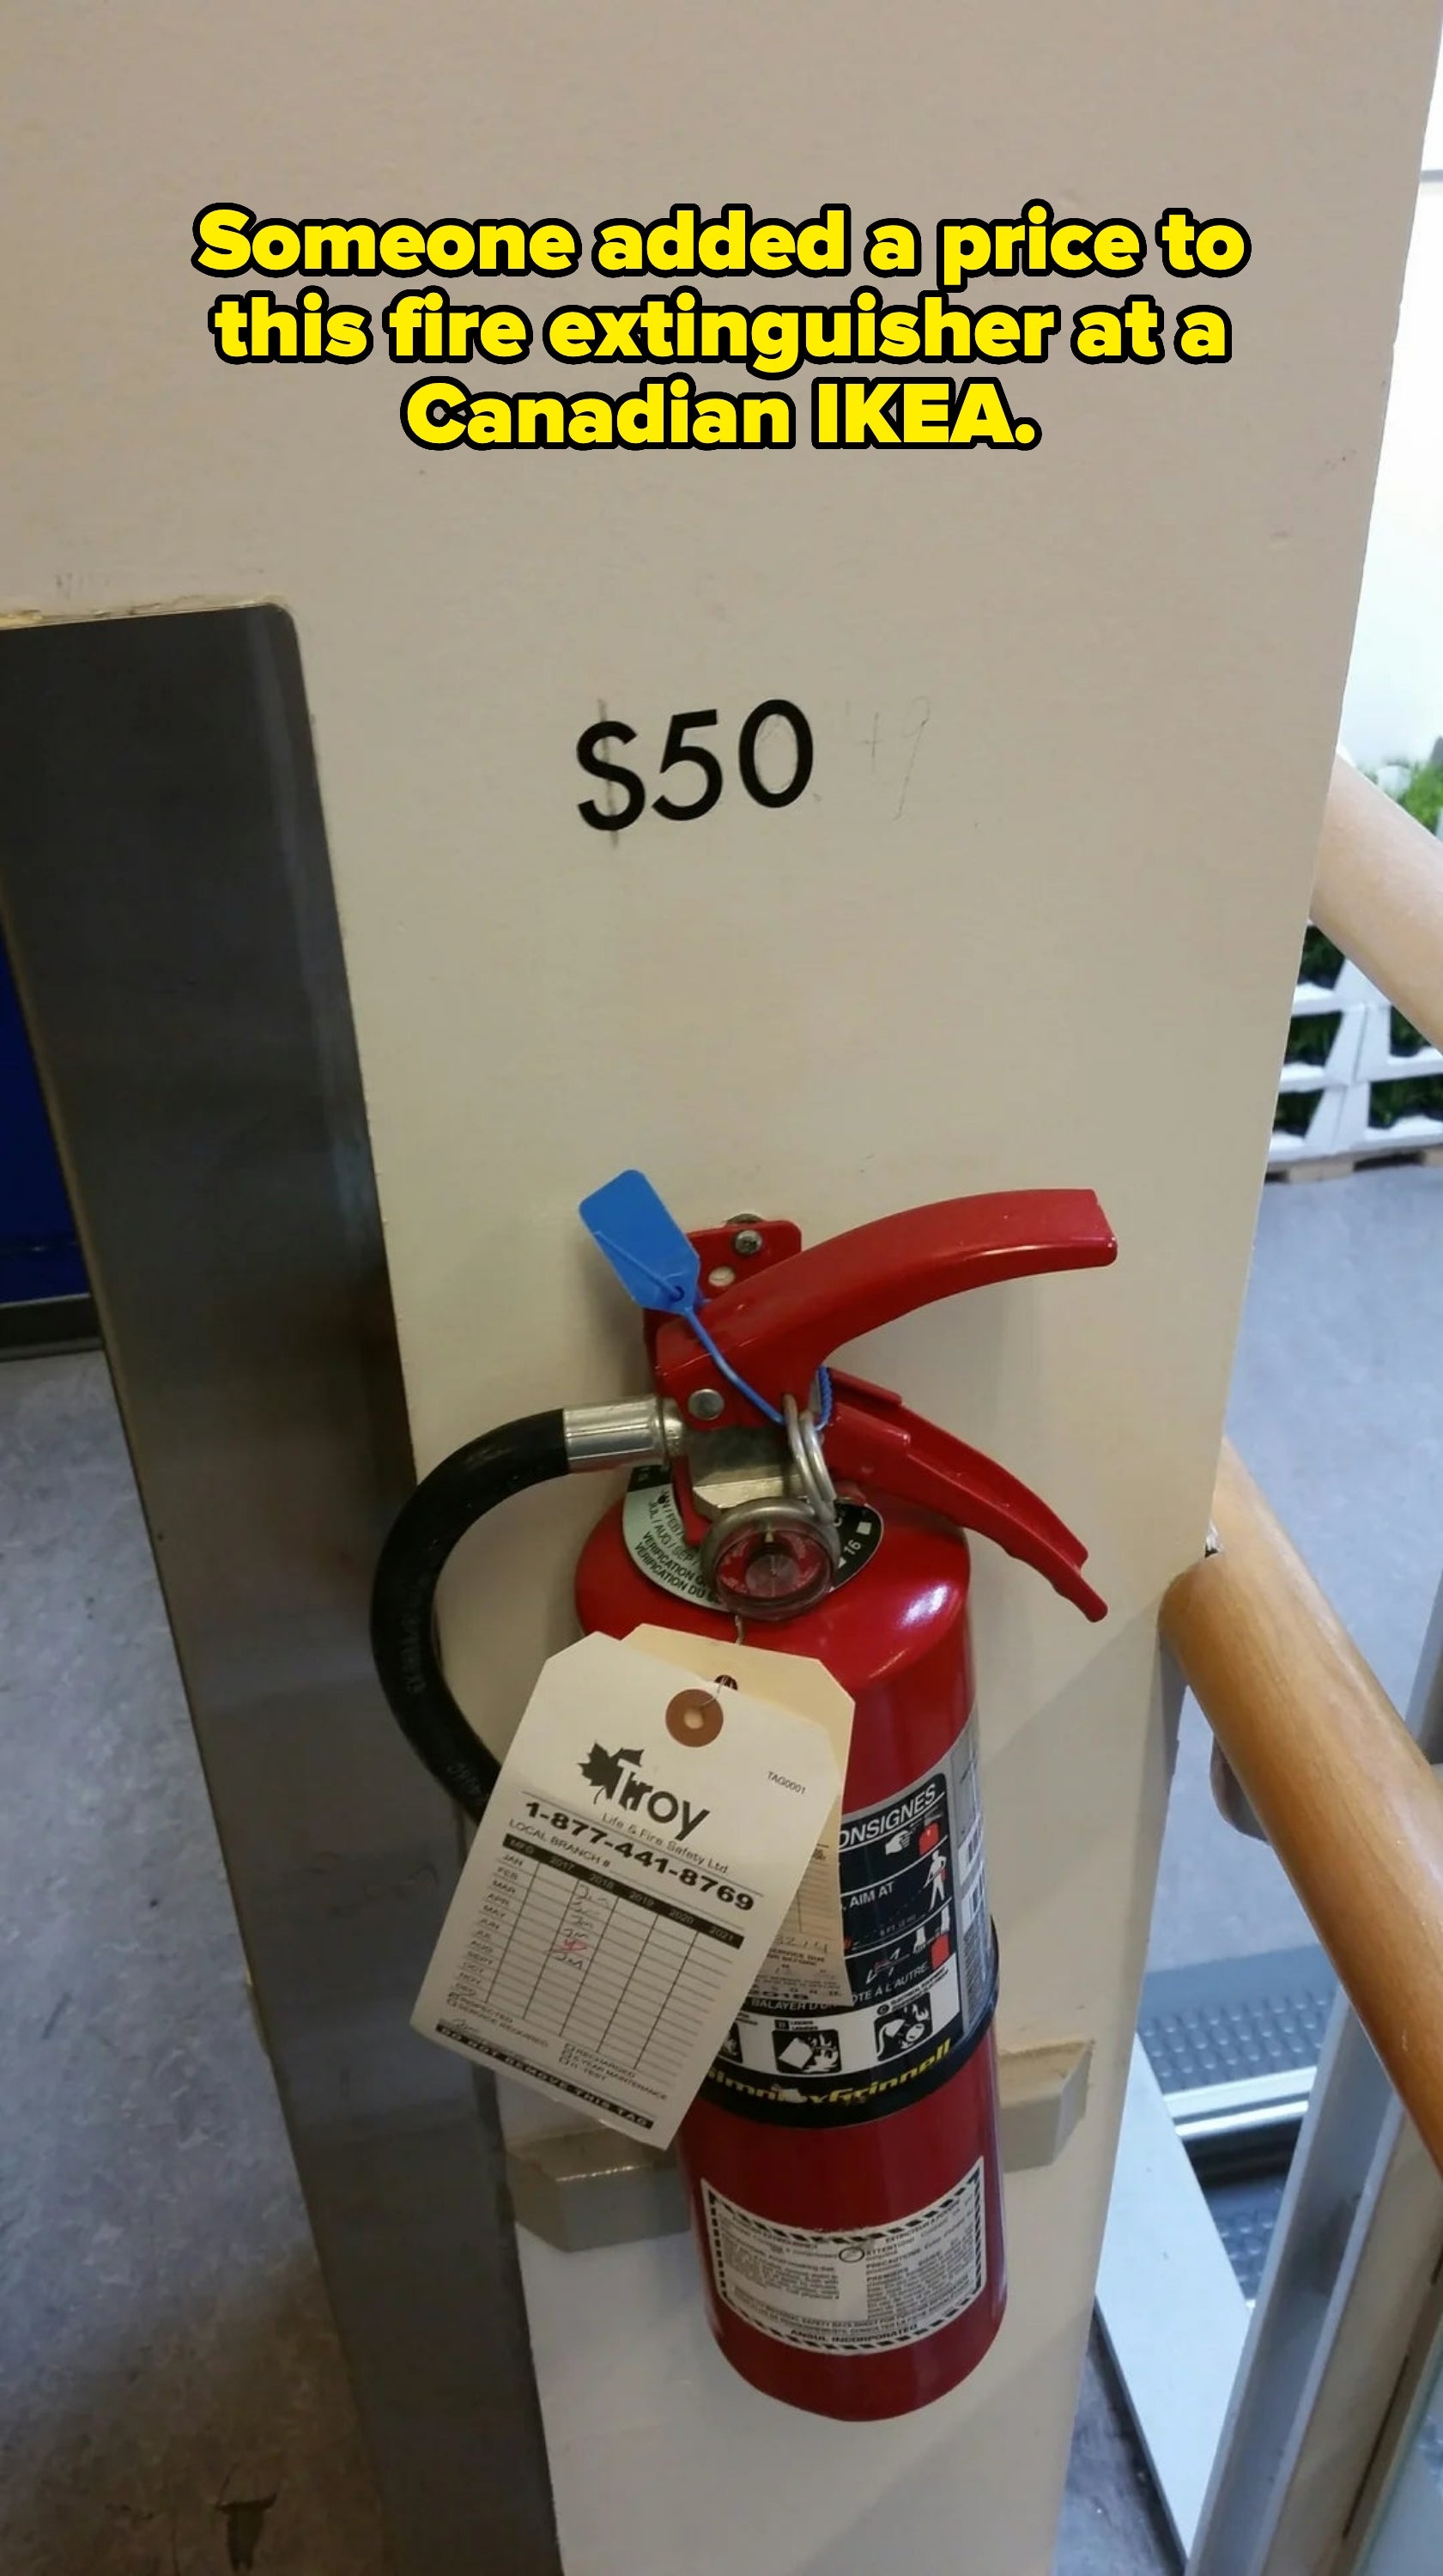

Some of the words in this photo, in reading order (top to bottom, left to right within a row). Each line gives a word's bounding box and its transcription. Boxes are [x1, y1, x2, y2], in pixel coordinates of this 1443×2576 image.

[576, 699, 814, 848] $50
[843, 1540, 861, 1556] 16
[688, 1586, 706, 1599] DU
[616, 1759, 711, 1841] Troy
[840, 1783, 937, 1847] ONSIGNES
[508, 1818, 547, 1843] LOCAL
[551, 1836, 602, 1865] BRANCH
[603, 1859, 611, 1869] #
[525, 1801, 755, 1911] 1-877-441-8769
[601, 1811, 626, 1831] Life
[639, 1827, 665, 1848] Fire
[666, 1839, 706, 1867] Safety
[550, 1855, 575, 1871] 2017
[669, 1909, 694, 1925] 2020
[711, 1926, 735, 1941] 2021
[849, 1891, 876, 1909] AIM
[878, 1881, 894, 1899] AT
[885, 1961, 930, 1993] L'AUTRE
[441, 2027, 463, 2042] DO
[468, 2038, 498, 2057] NOT
[506, 2055, 569, 2090] REMOVE
[575, 2088, 611, 2111] THIS
[617, 2107, 652, 2127] TAG
